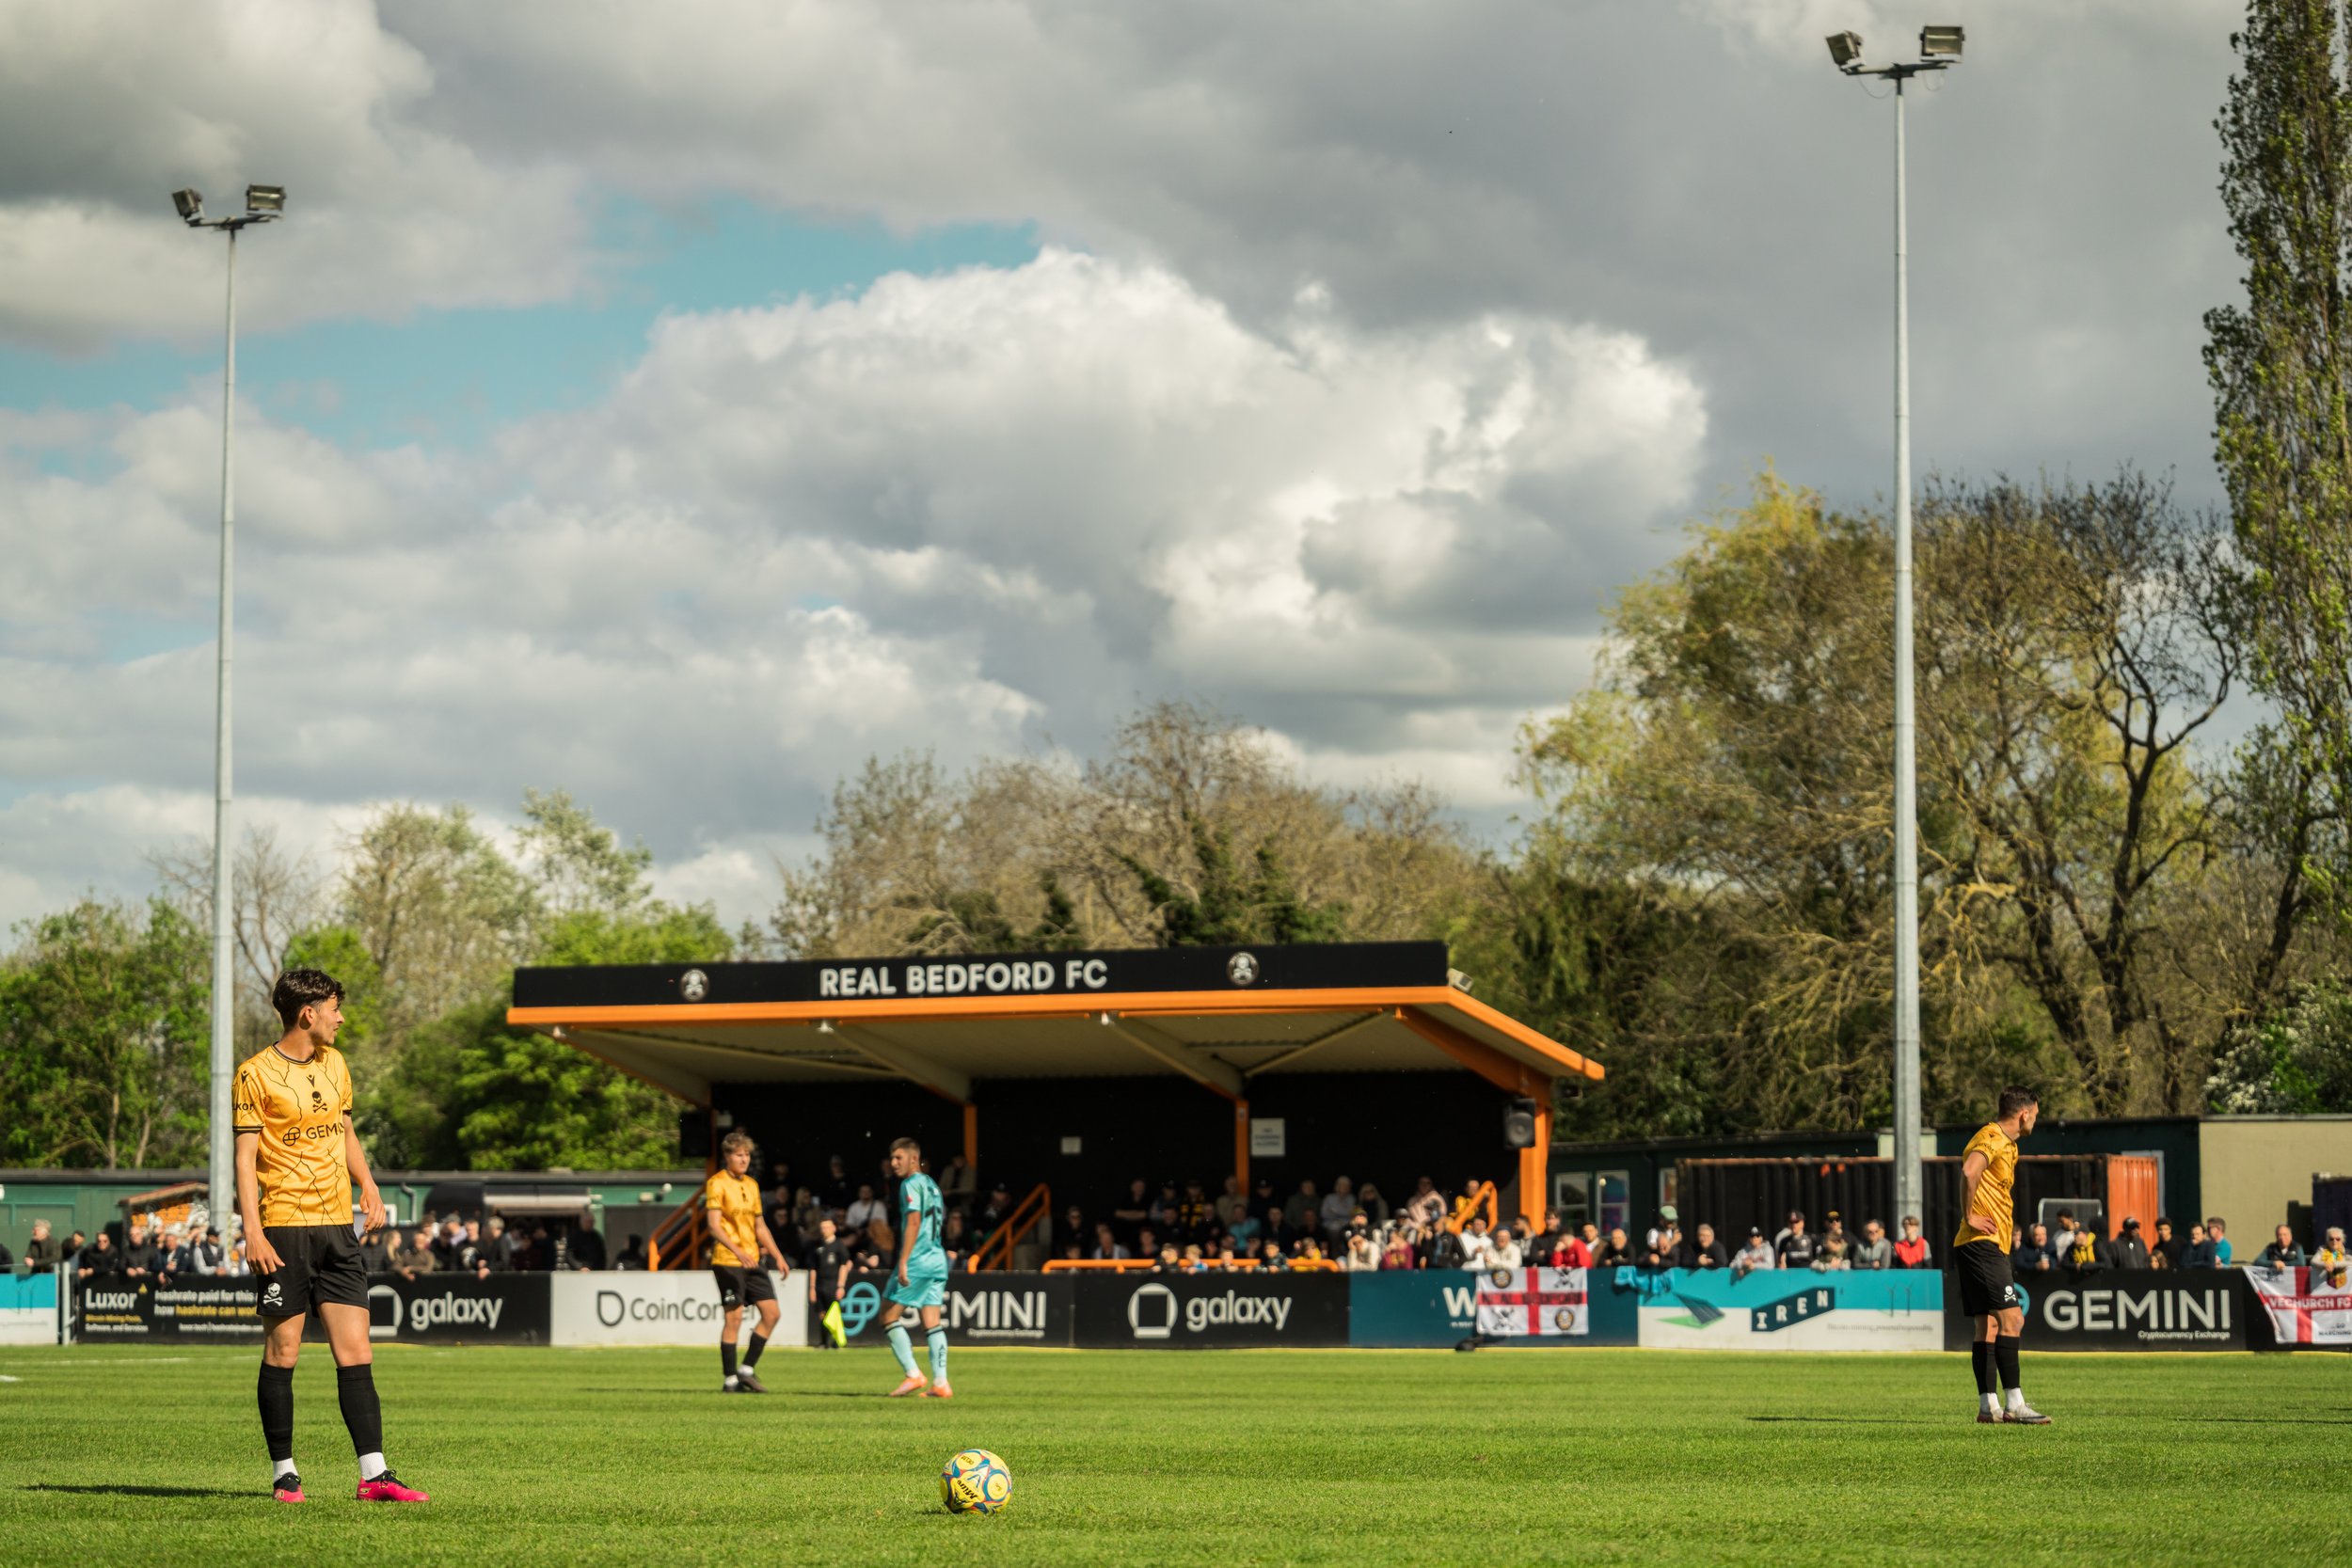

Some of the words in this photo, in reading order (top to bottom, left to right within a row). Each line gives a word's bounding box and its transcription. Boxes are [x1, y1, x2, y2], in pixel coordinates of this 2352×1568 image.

[819, 966, 897, 996] REAL
[906, 961, 1056, 993] BEDFORD
[1065, 959, 1107, 989] FC
[86, 1289, 137, 1308] Luxor
[154, 1304, 175, 1316] how
[175, 1304, 218, 1316] hashrate
[218, 1306, 236, 1316] can
[198, 1290, 220, 1305] paid
[220, 1290, 234, 1302] for
[235, 1290, 255, 1302] this
[410, 1291, 503, 1331] galaxy
[1185, 1290, 1293, 1332] galaxy
[1756, 1290, 1829, 1329] IREN
[2043, 1290, 2231, 1331] GEMINI
[2137, 1330, 2194, 1340] Cryptocurrency
[2194, 1330, 2231, 1340] Exchange
